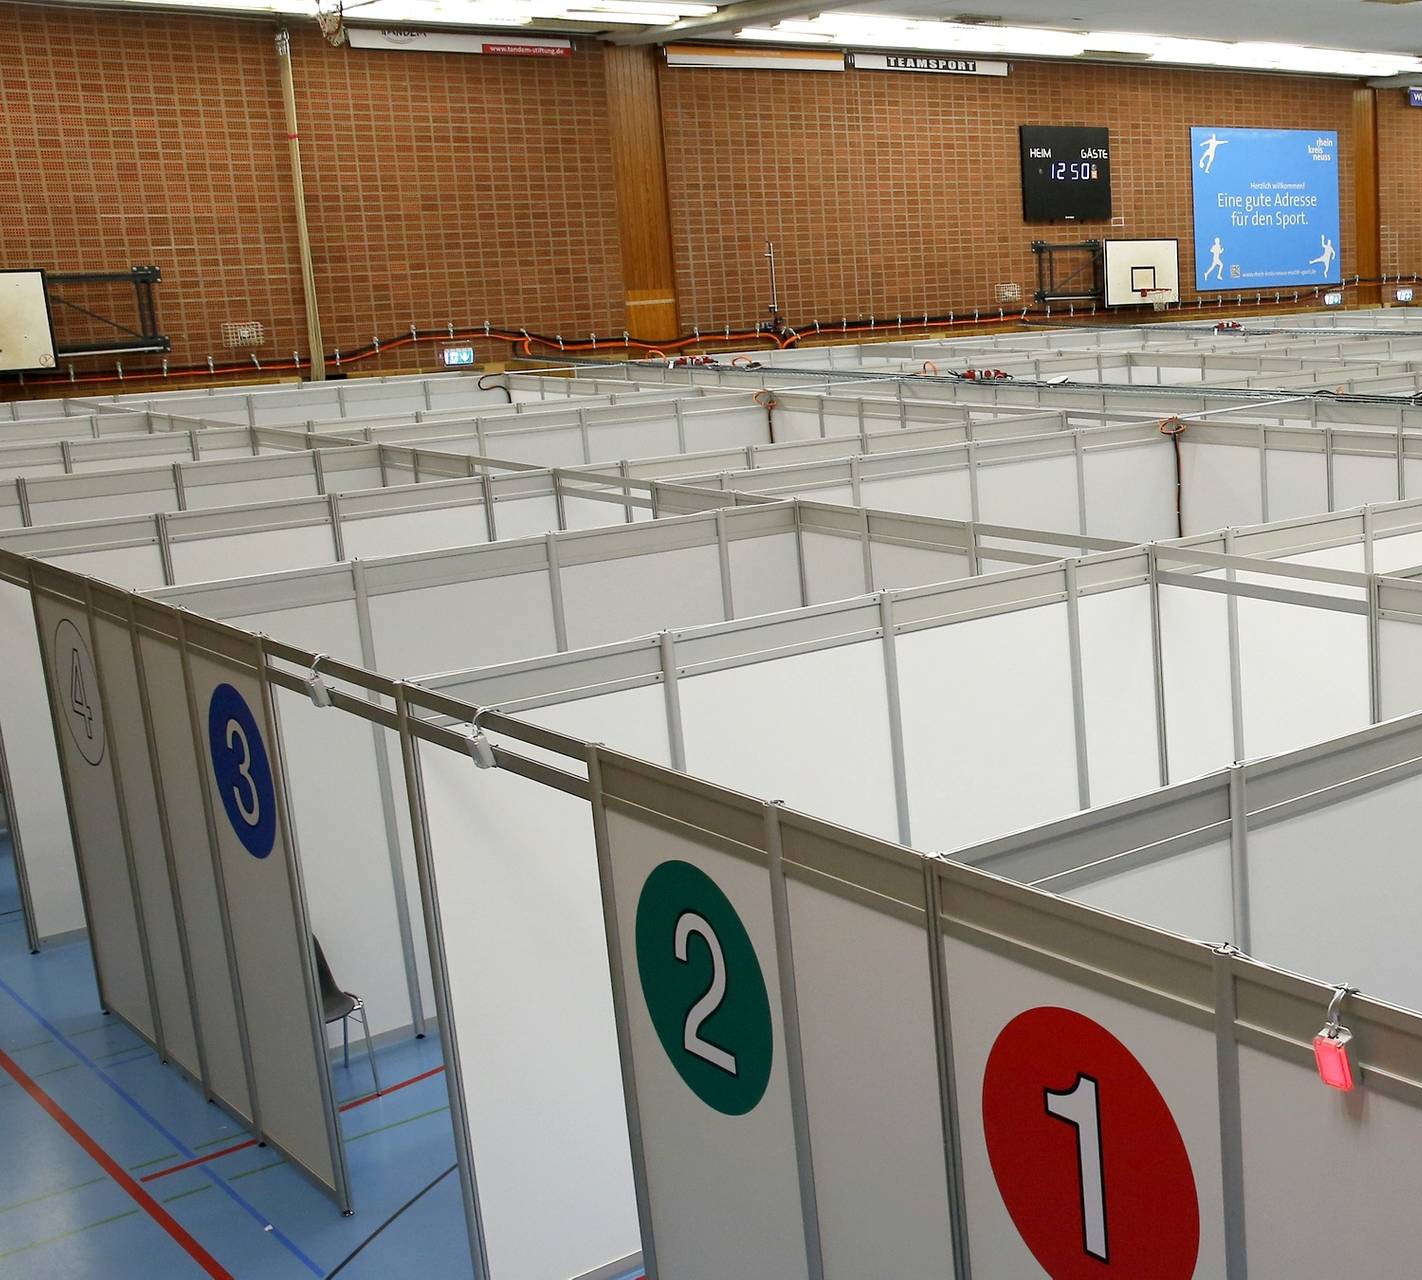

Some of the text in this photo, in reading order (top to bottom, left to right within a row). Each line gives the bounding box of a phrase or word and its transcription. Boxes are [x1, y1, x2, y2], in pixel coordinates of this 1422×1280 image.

[887, 57, 976, 71] TEAMSPORT
[1307, 144, 1324, 154] kreis
[1316, 137, 1333, 147] rhein
[1029, 147, 1108, 159] HEIM GÄSTE
[1312, 153, 1331, 161] neuss
[1249, 181, 1272, 190] Herzlich
[1217, 191, 1317, 212] Eine gute Adresse
[1231, 210, 1309, 230] für den Sport.
[71, 647, 94, 740] 4
[225, 716, 261, 828] 3
[673, 910, 738, 1077] 2
[1042, 1071, 1111, 1266] 1
